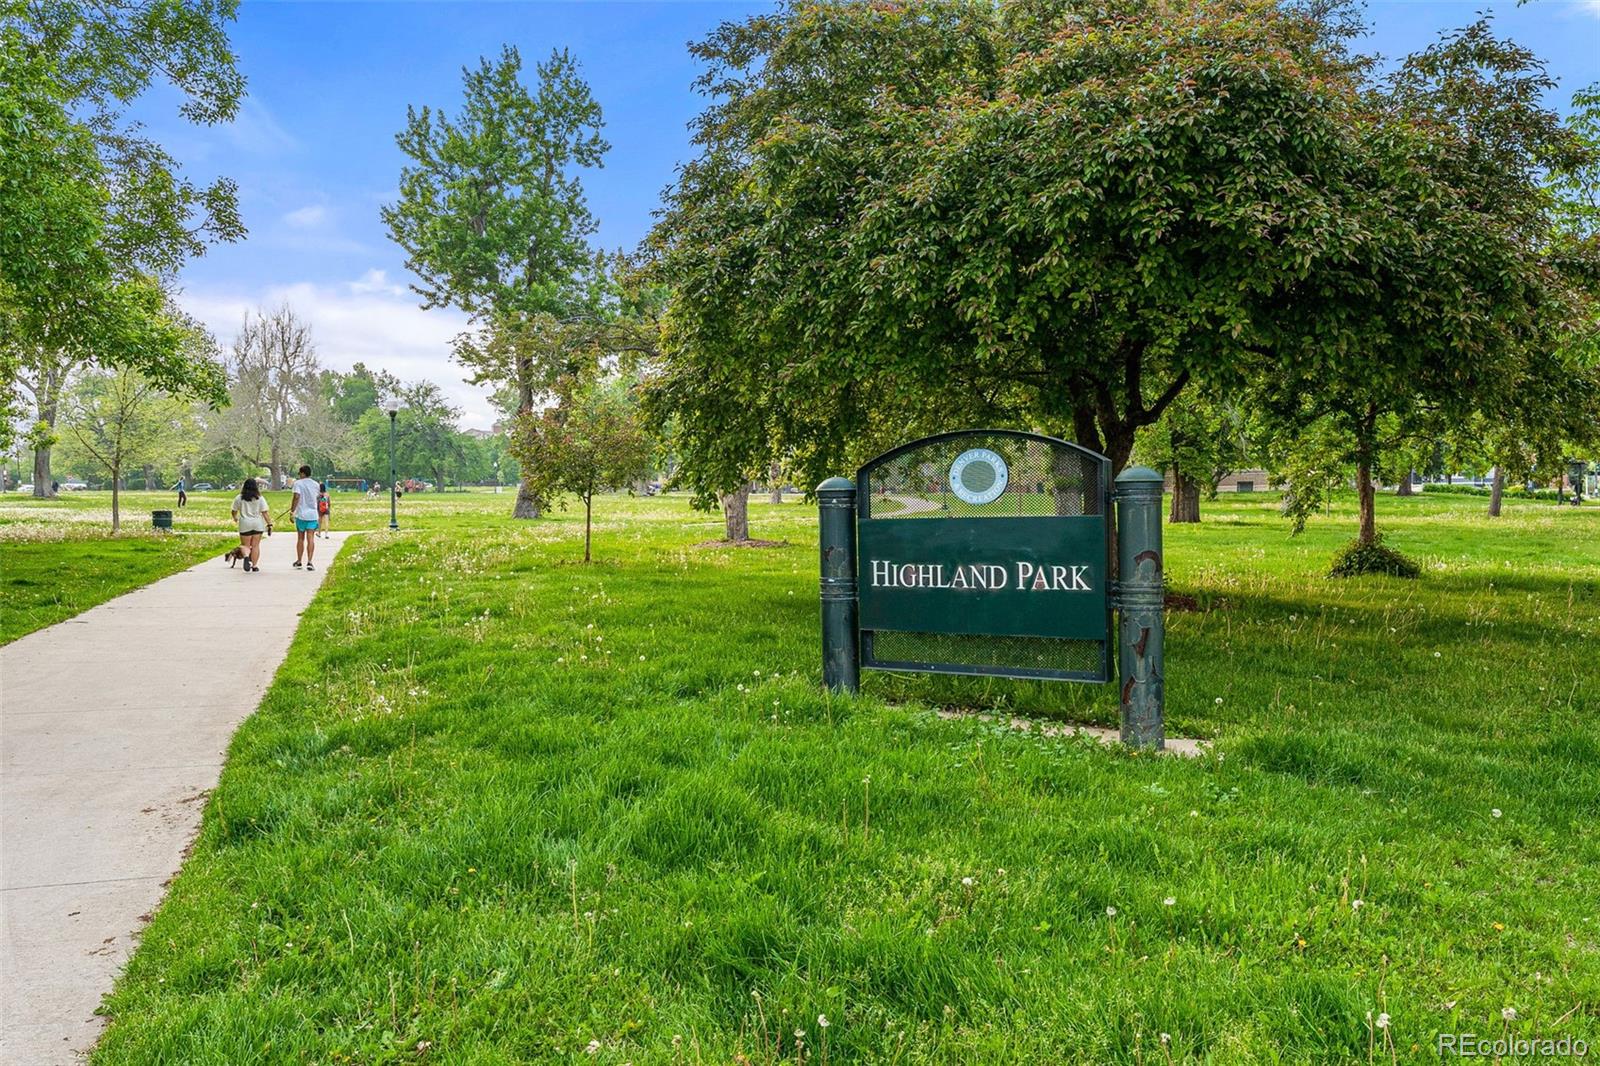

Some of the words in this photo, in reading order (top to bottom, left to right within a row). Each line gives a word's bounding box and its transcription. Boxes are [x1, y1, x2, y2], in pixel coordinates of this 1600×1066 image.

[954, 451, 980, 474] DENVER
[981, 451, 1004, 474] PARKS
[958, 480, 1005, 502] RECREATION
[870, 560, 1008, 589] HIGHLAND
[1016, 561, 1092, 591] PARK
